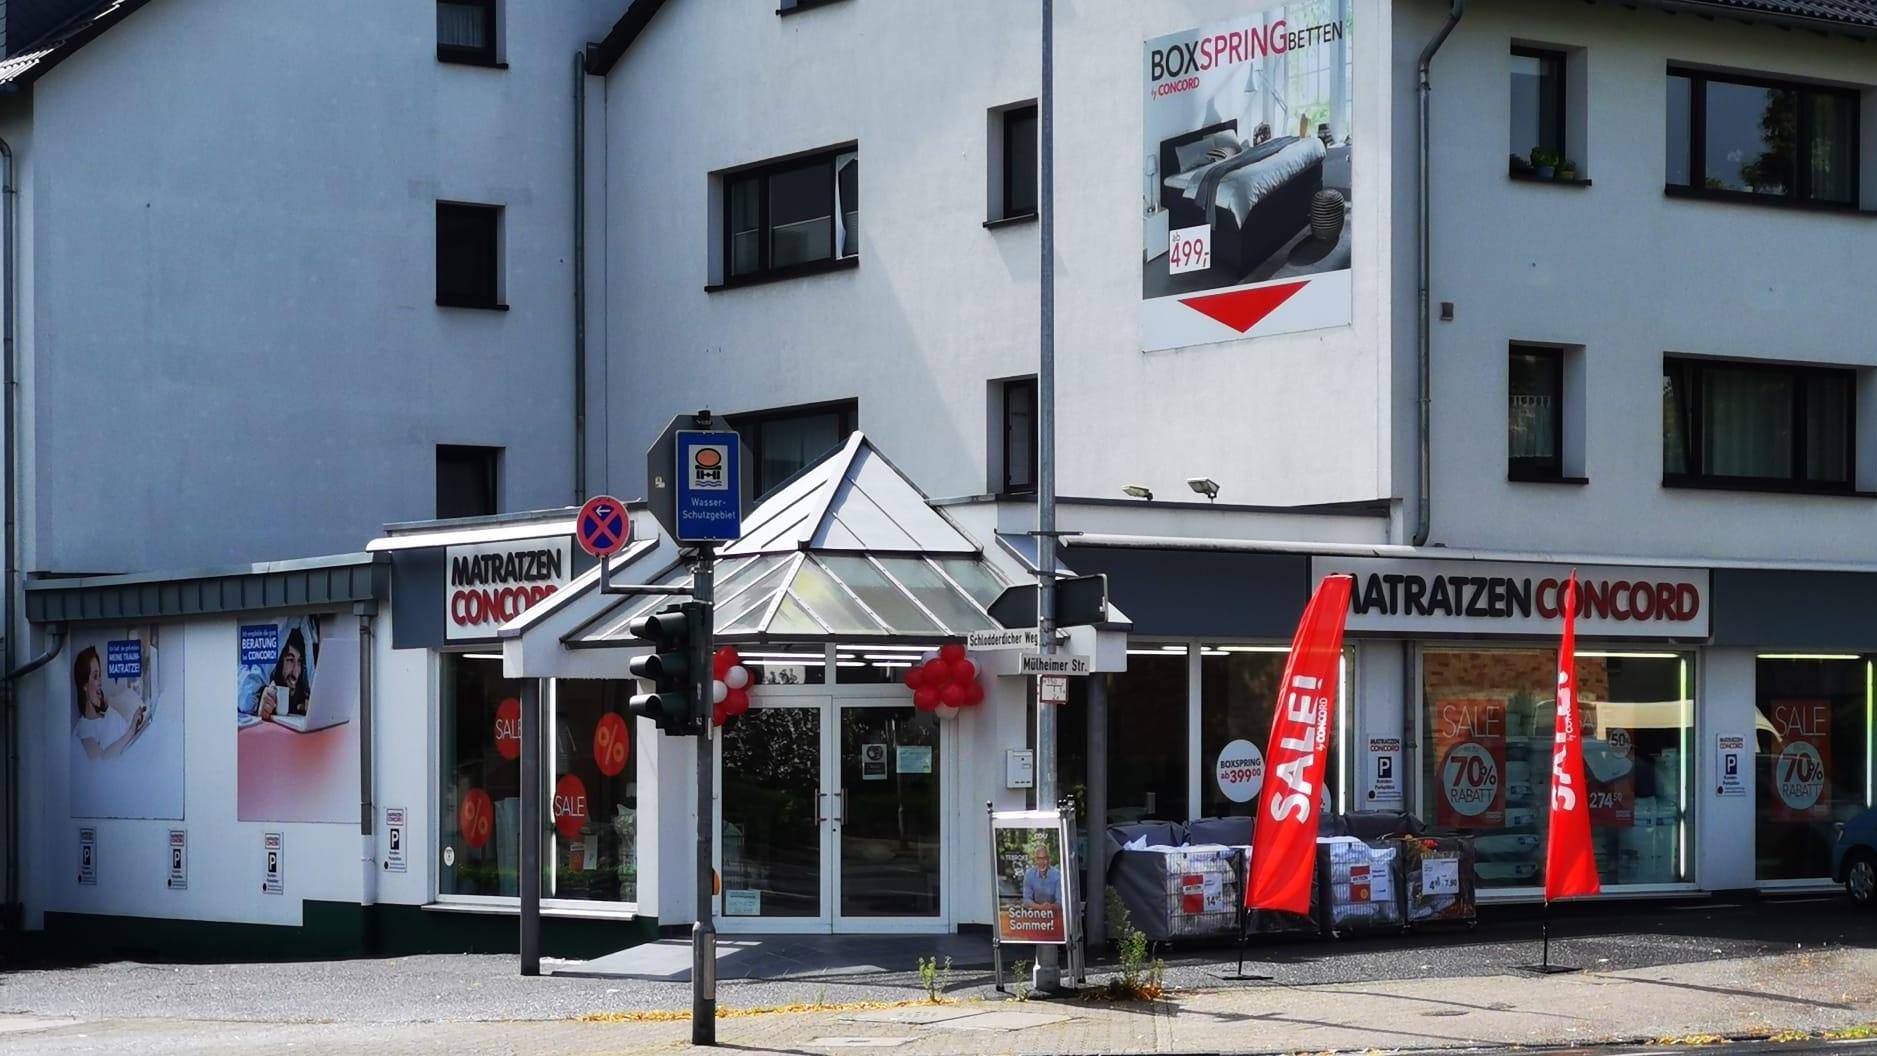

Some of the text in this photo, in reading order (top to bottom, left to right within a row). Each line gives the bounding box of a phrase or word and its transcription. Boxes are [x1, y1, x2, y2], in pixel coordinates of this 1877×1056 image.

[1158, 78, 1200, 96] CONCORD
[691, 497, 727, 507] Wasser-
[682, 510, 736, 521] Schutzgebiet
[451, 548, 562, 586] MATRATZEN
[1535, 577, 1700, 621] CONCORD
[241, 637, 277, 649] BERATUNG
[969, 631, 1038, 648] Schlodderdicher Weg
[1023, 657, 1088, 672] Mülheimer Str.
[1315, 697, 1328, 743] CONCORD
[1443, 704, 1500, 738] SALE
[1775, 705, 1827, 737] SALE
[1220, 758, 1261, 769] BOXSPRING
[1380, 758, 1390, 777] P
[1450, 755, 1497, 788] 70%
[1727, 756, 1736, 773] P
[1781, 752, 1824, 783] 70%
[1450, 788, 1495, 803] RABATT
[1782, 783, 1821, 798] RABATT
[554, 795, 585, 817] SALE
[391, 831, 399, 848] P
[1008, 906, 1054, 919] Schönen
[1009, 919, 1054, 931] Sommer!
